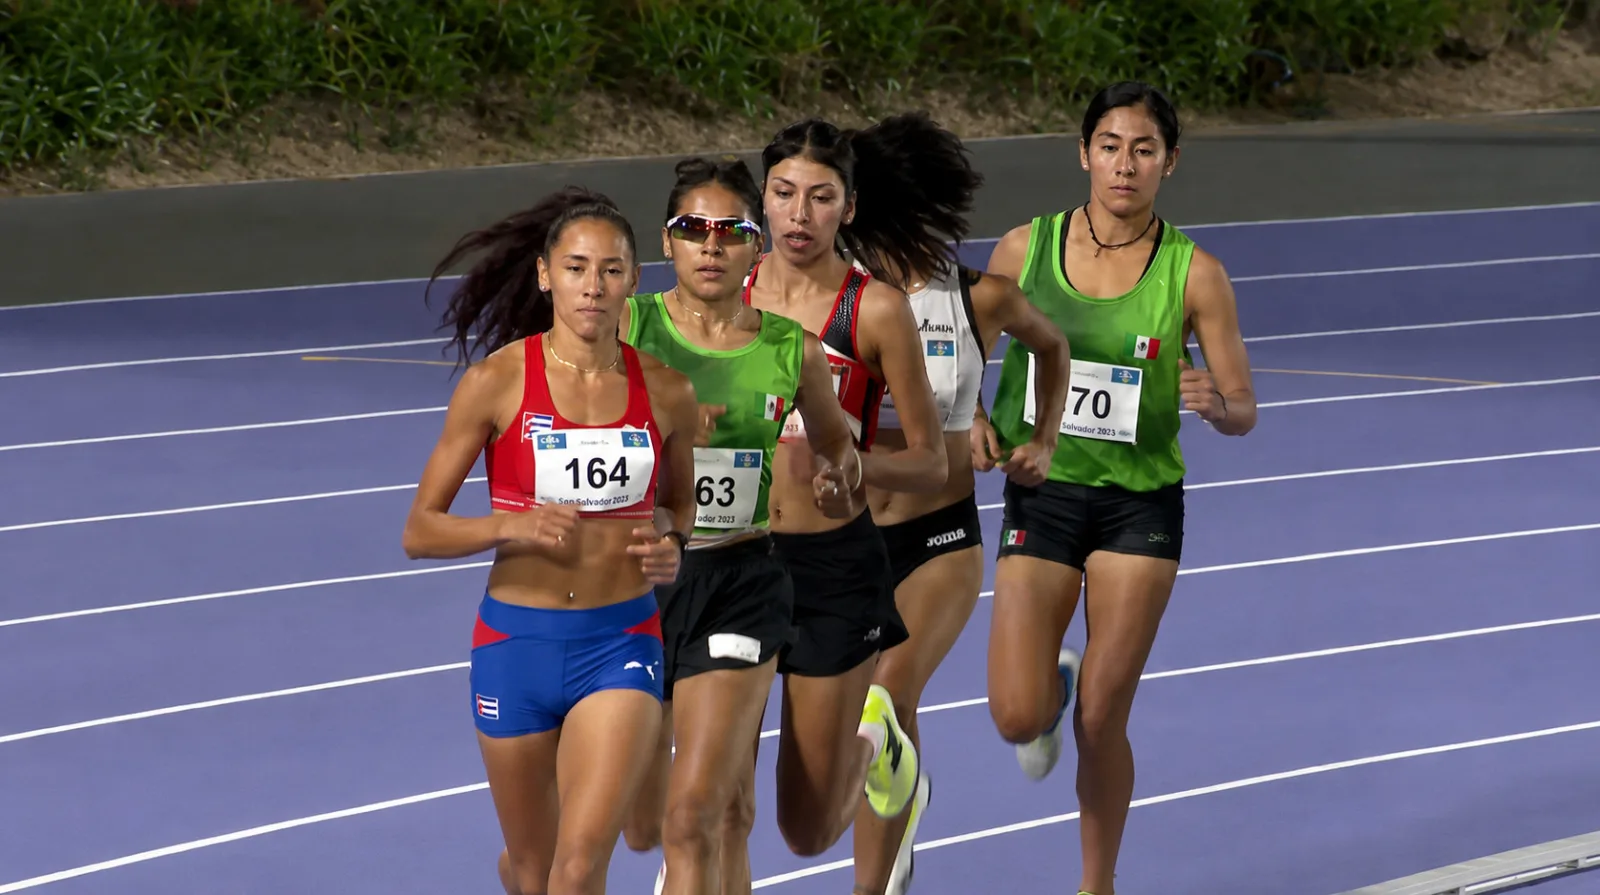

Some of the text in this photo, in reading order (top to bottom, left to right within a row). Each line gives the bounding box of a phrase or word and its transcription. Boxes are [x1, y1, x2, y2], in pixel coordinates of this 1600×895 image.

[1063, 386, 1111, 419] 70
[1062, 422, 1096, 433] Salvador
[1097, 427, 1116, 437] 2023
[565, 456, 630, 489] 164
[558, 497, 575, 505] San
[576, 498, 612, 506] Salvador
[695, 476, 735, 507] 63
[697, 514, 736, 524] ador 2023
